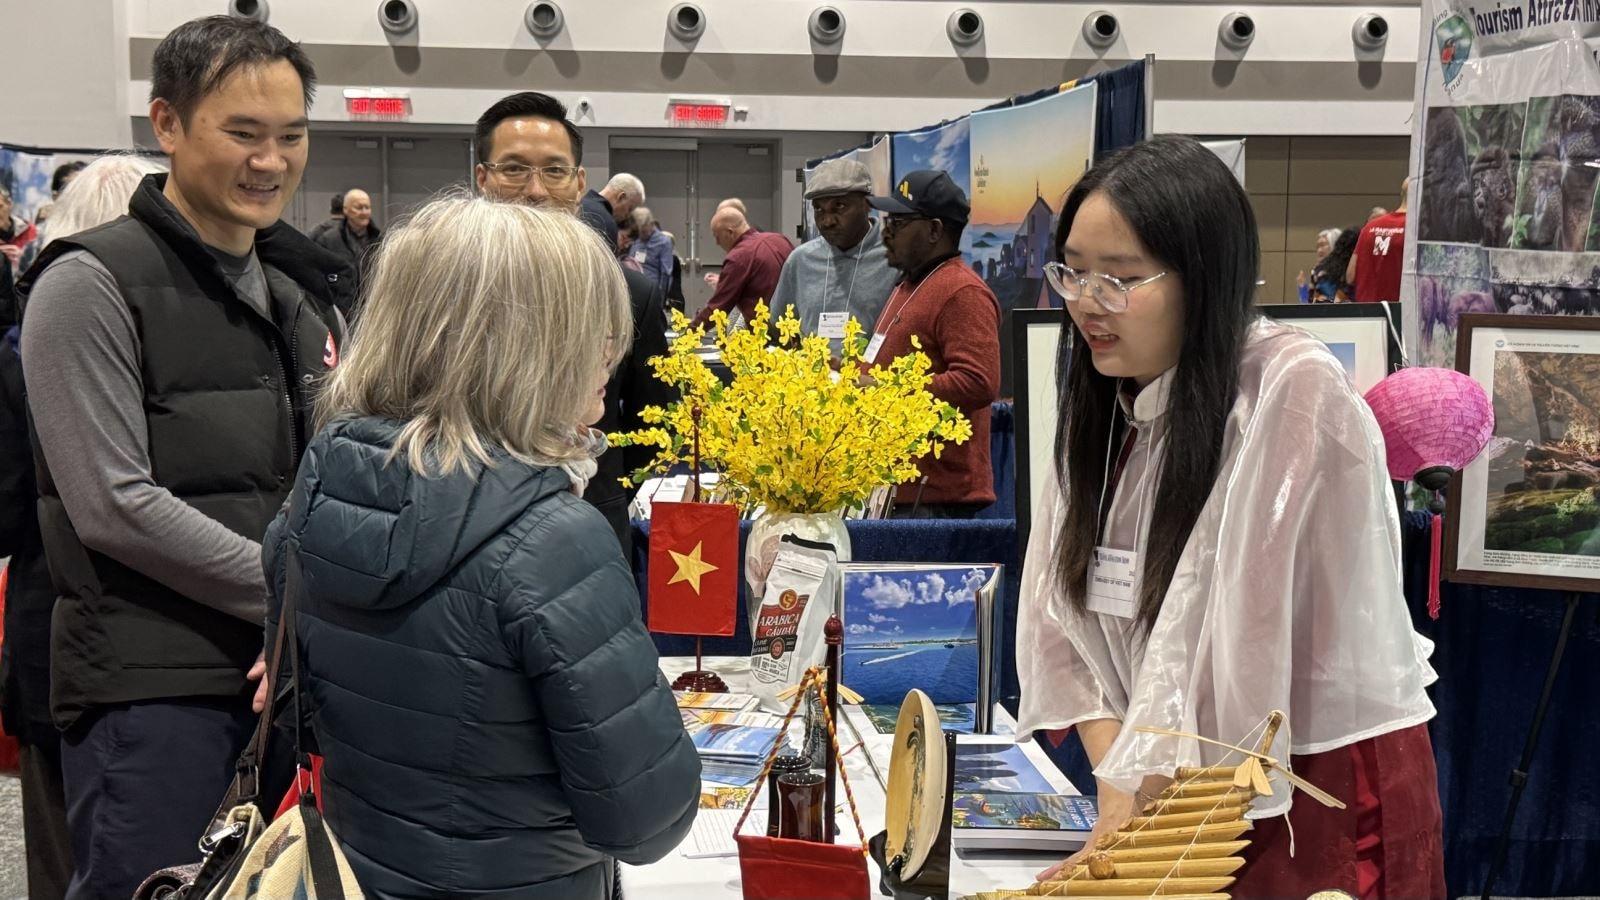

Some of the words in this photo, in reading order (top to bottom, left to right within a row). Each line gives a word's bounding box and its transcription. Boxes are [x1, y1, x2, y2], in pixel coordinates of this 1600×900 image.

[1469, 2, 1523, 36] Tourism
[351, 99, 370, 113] EXIT
[374, 99, 404, 114] SORTIE
[675, 105, 693, 120] EXIT
[697, 106, 725, 121] SORTIE
[759, 613, 799, 627] ARABICA
